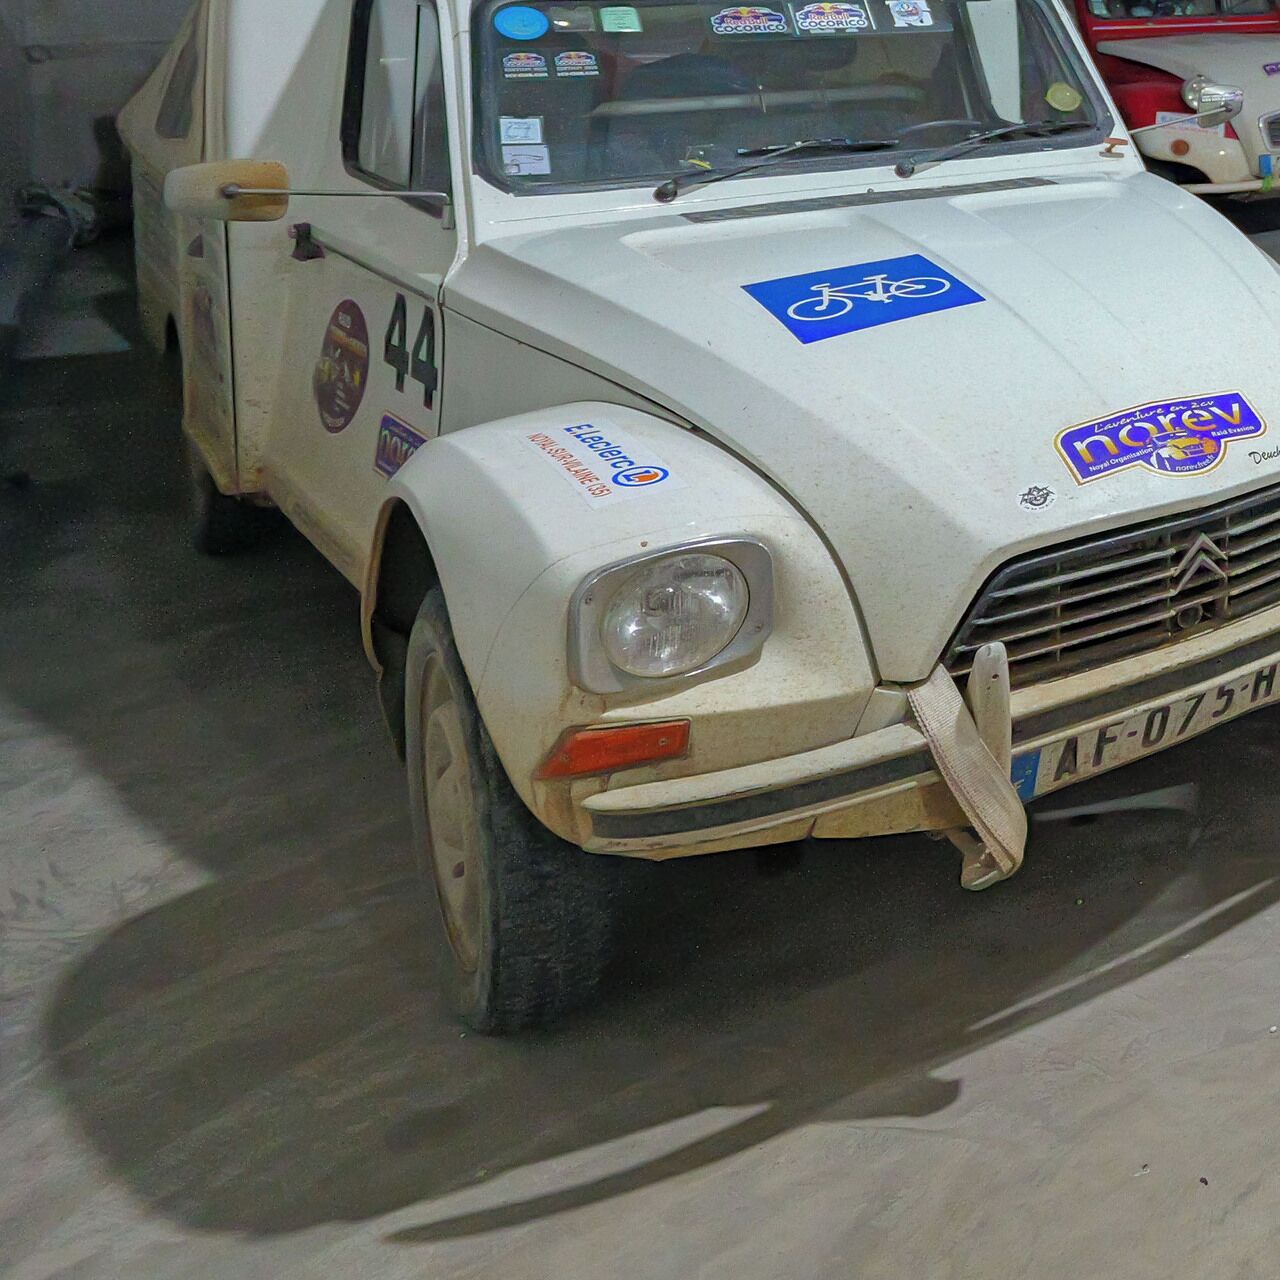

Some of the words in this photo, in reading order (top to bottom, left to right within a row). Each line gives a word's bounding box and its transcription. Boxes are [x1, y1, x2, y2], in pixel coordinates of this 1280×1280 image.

[714, 23, 786, 33] COCORICO
[799, 19, 866, 29] COCORICO
[383, 291, 438, 411] 44
[563, 423, 635, 469] E.Leclerc
[1072, 402, 1241, 464] norev
